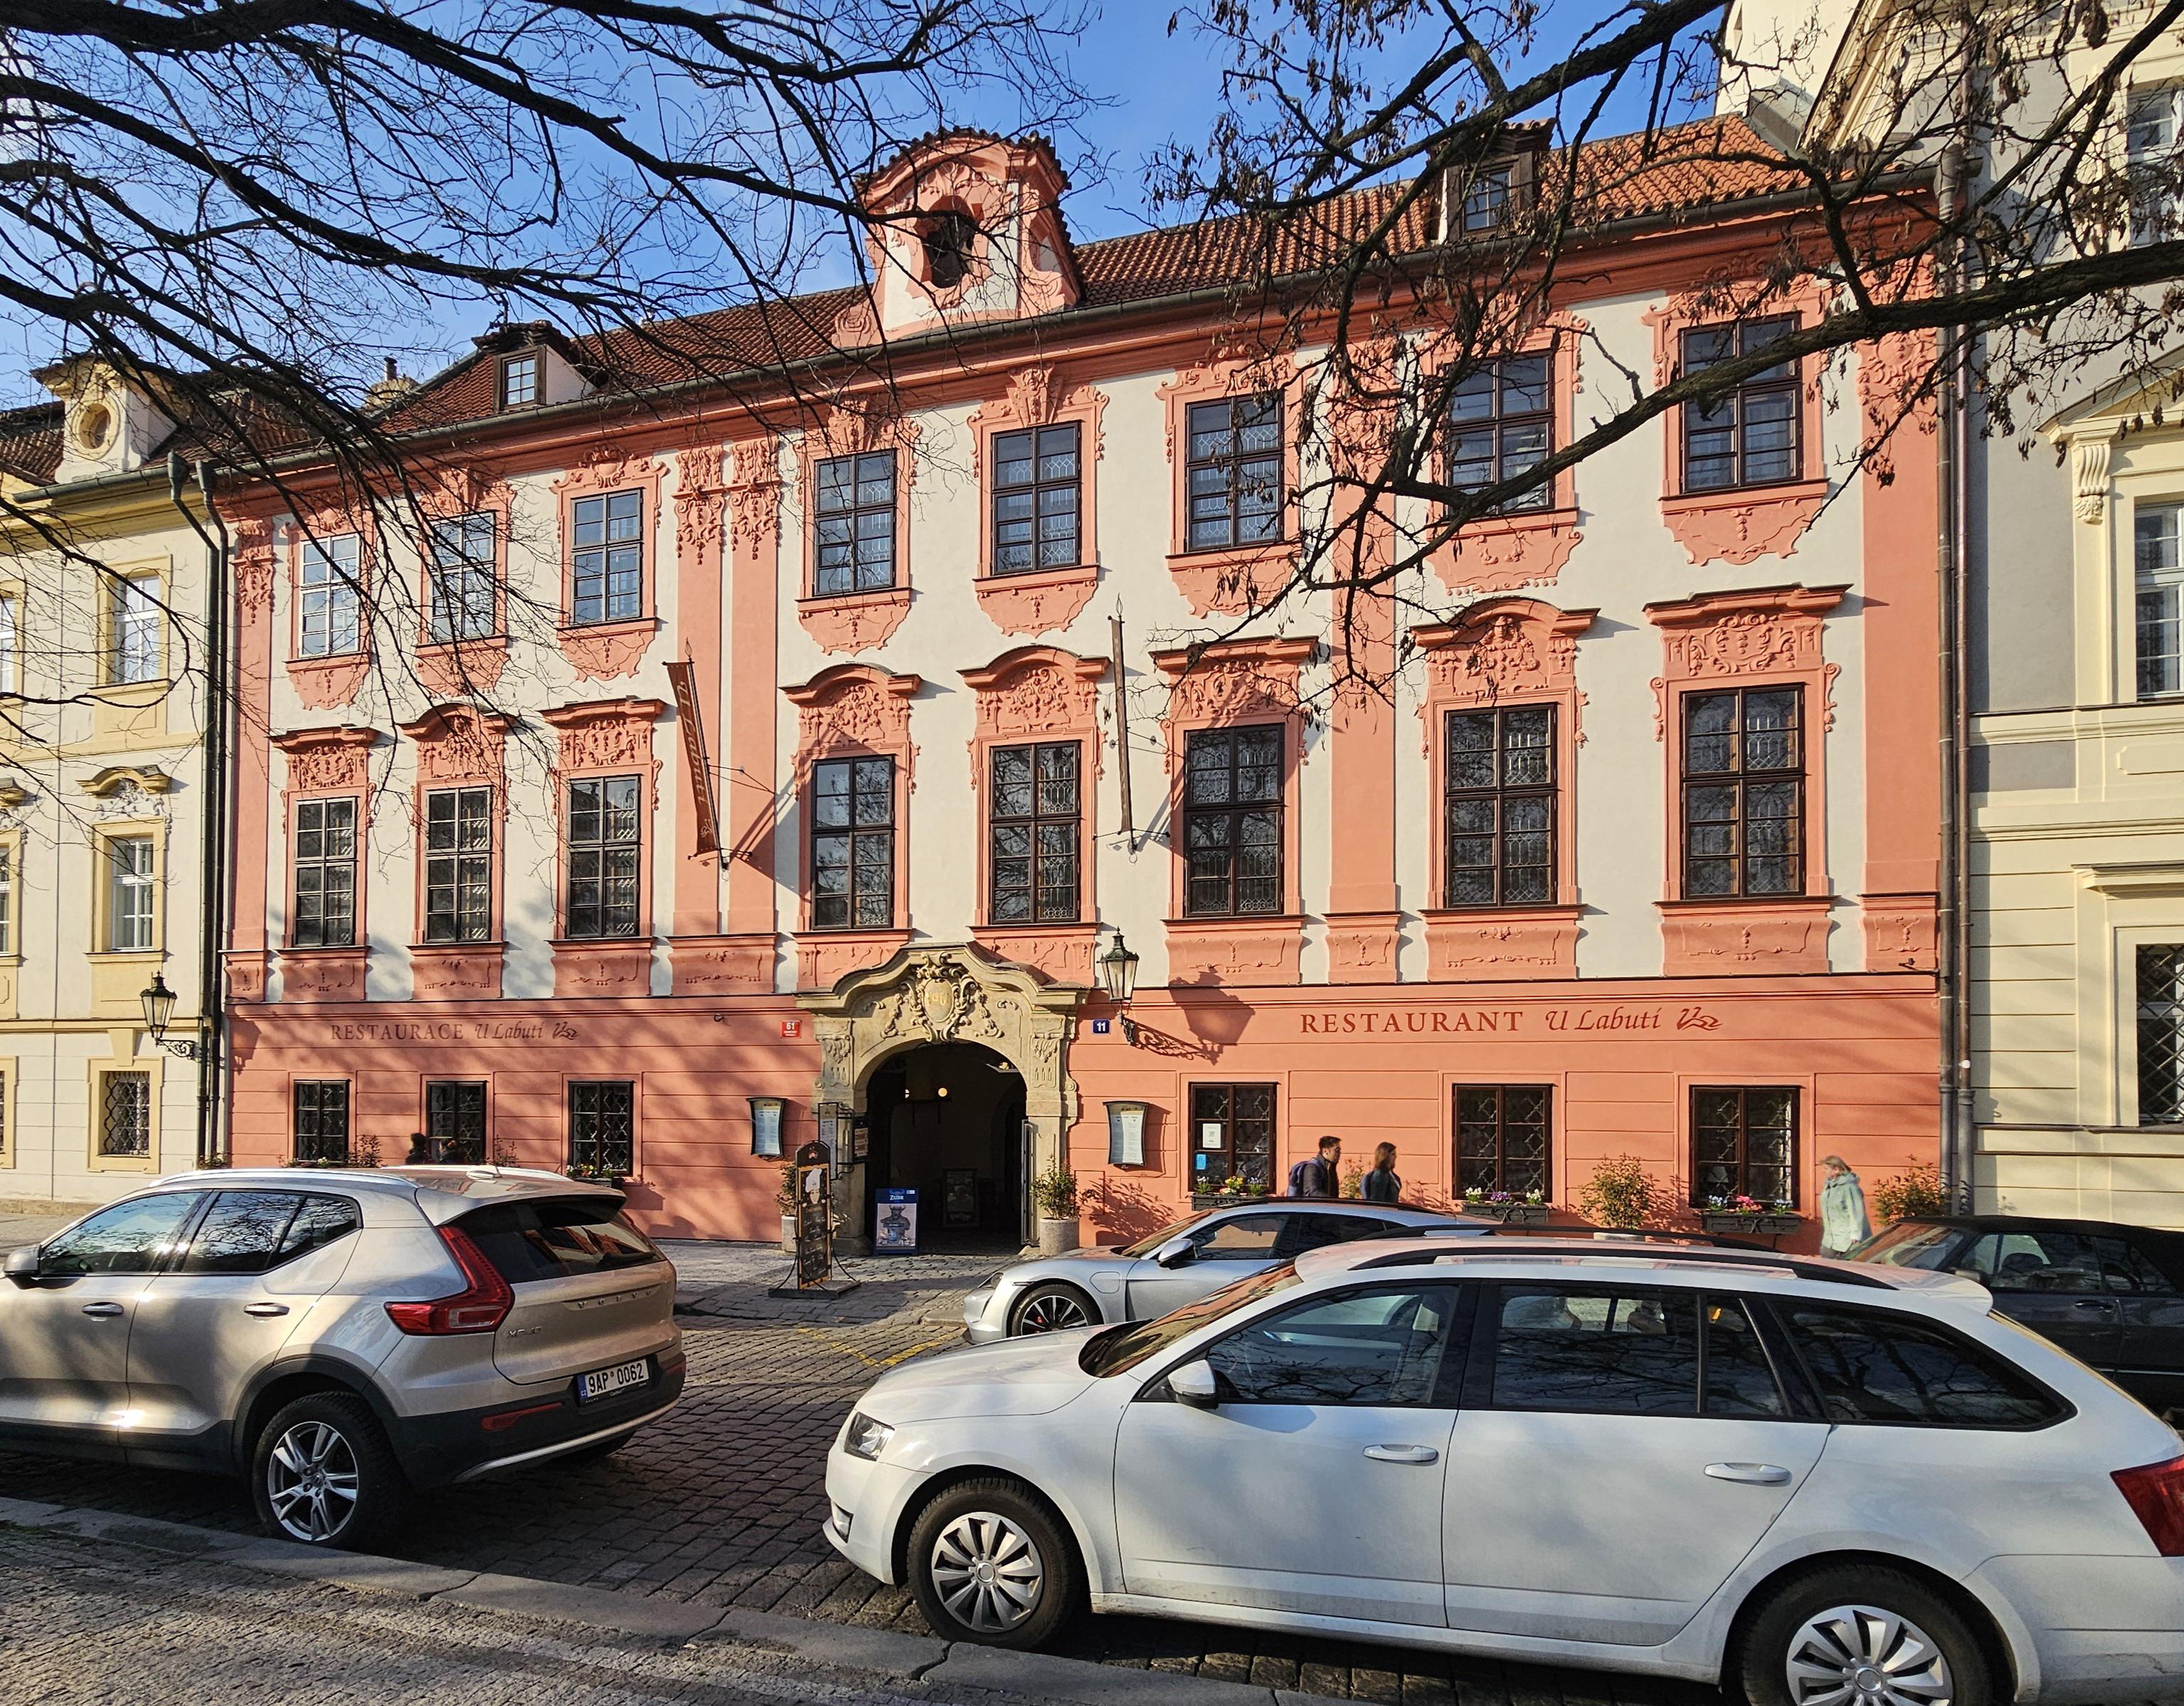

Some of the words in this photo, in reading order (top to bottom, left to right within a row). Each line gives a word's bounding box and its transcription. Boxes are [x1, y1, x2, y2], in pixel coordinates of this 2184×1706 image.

[786, 1022, 795, 1030] 61
[1096, 1022, 1106, 1032] 11
[1300, 1011, 1523, 1033] RESTAURANT
[1544, 1010, 1568, 1031] U
[1574, 1006, 1663, 1030] Labutí
[330, 1023, 465, 1040] RESTAURACE
[475, 1023, 489, 1039] U
[492, 1020, 545, 1039] Labutí
[588, 1372, 609, 1394] 9AP
[616, 1362, 645, 1385] 0062
